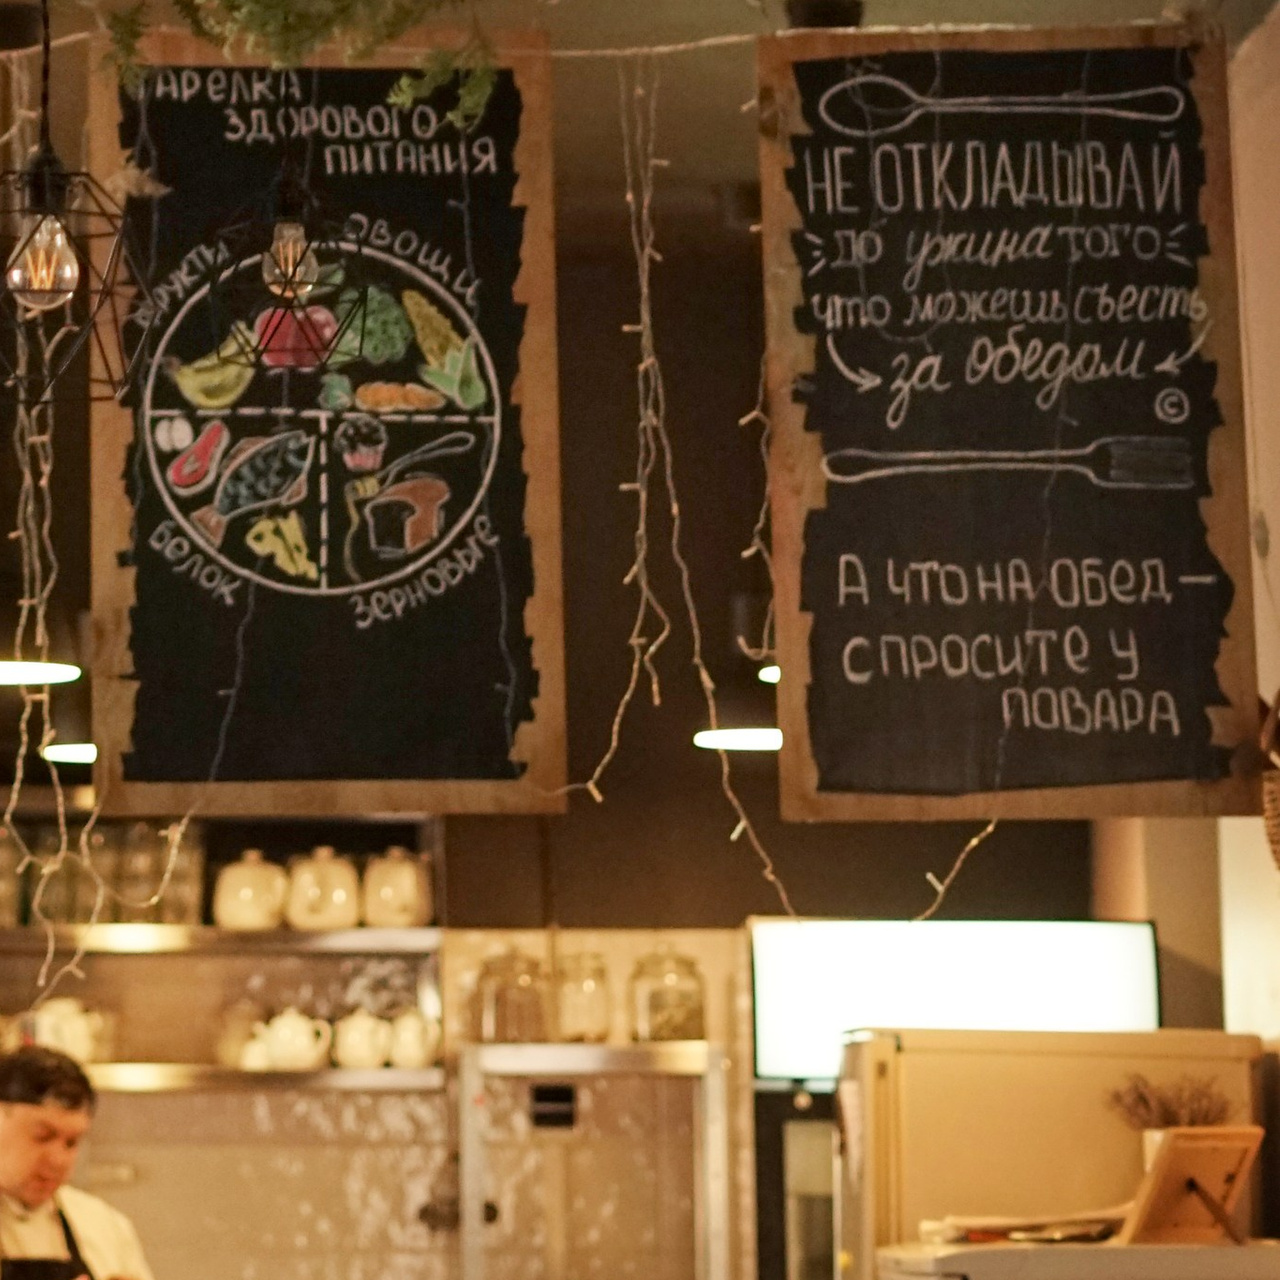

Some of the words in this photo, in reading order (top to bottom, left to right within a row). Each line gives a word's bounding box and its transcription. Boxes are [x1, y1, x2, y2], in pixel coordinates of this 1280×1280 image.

[223, 104, 438, 146] ЗДОРОВОГО
[324, 135, 499, 176] ПИТАНИЯ
[804, 145, 860, 215] НЕ
[873, 131, 1183, 215] ОТКЛАДЫВАЙ
[902, 222, 1054, 293] ужина
[811, 292, 892, 329] что
[903, 285, 1071, 327] можешь
[1073, 280, 1210, 323] съесть
[885, 348, 953, 430] за
[837, 553, 869, 607] А
[887, 558, 969, 607] ЧТО
[976, 557, 1036, 605] НА
[1001, 686, 1181, 737] ПОВАРА
